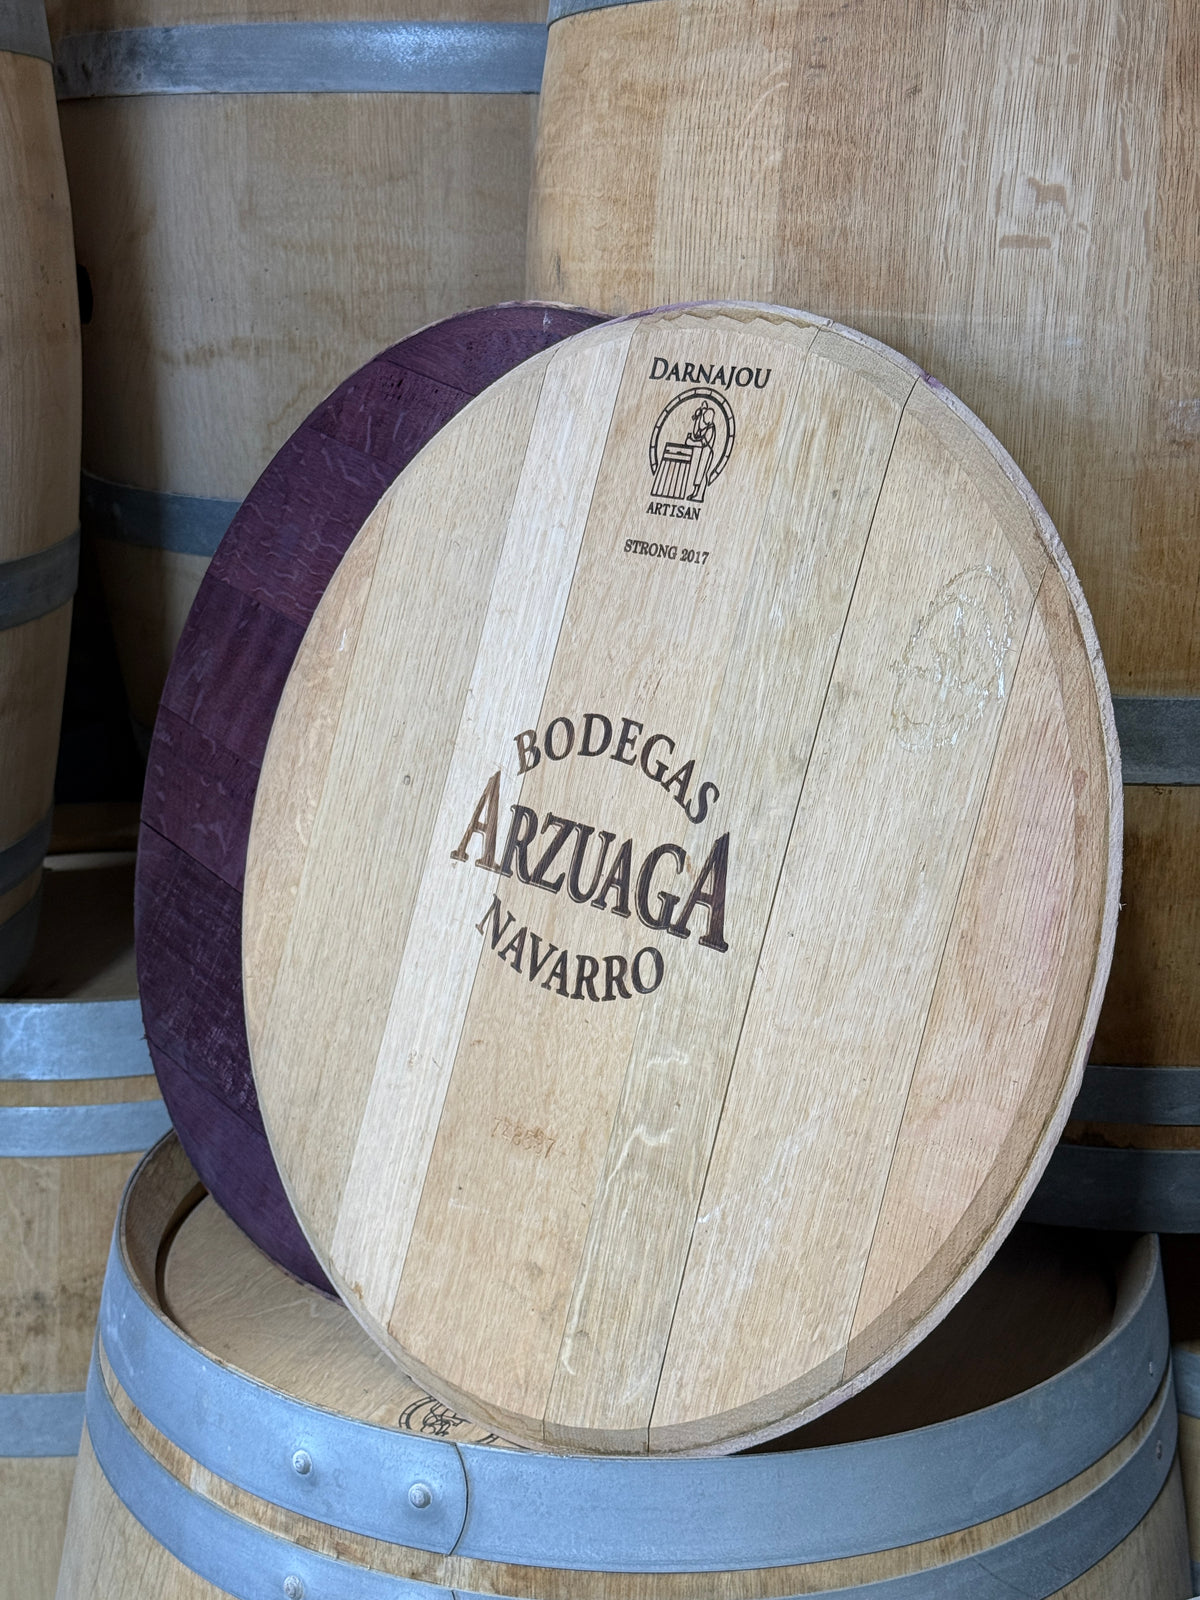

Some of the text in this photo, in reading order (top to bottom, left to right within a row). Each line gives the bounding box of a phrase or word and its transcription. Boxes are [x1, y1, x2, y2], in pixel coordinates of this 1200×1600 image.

[649, 357, 771, 390] DARNAJOU
[646, 501, 701, 521] ARTISAN
[623, 539, 709, 565] STRONG 2017
[513, 713, 720, 824] BODEGAS
[450, 770, 730, 953] ARZUAGA
[475, 893, 665, 1002] NAVARRO
